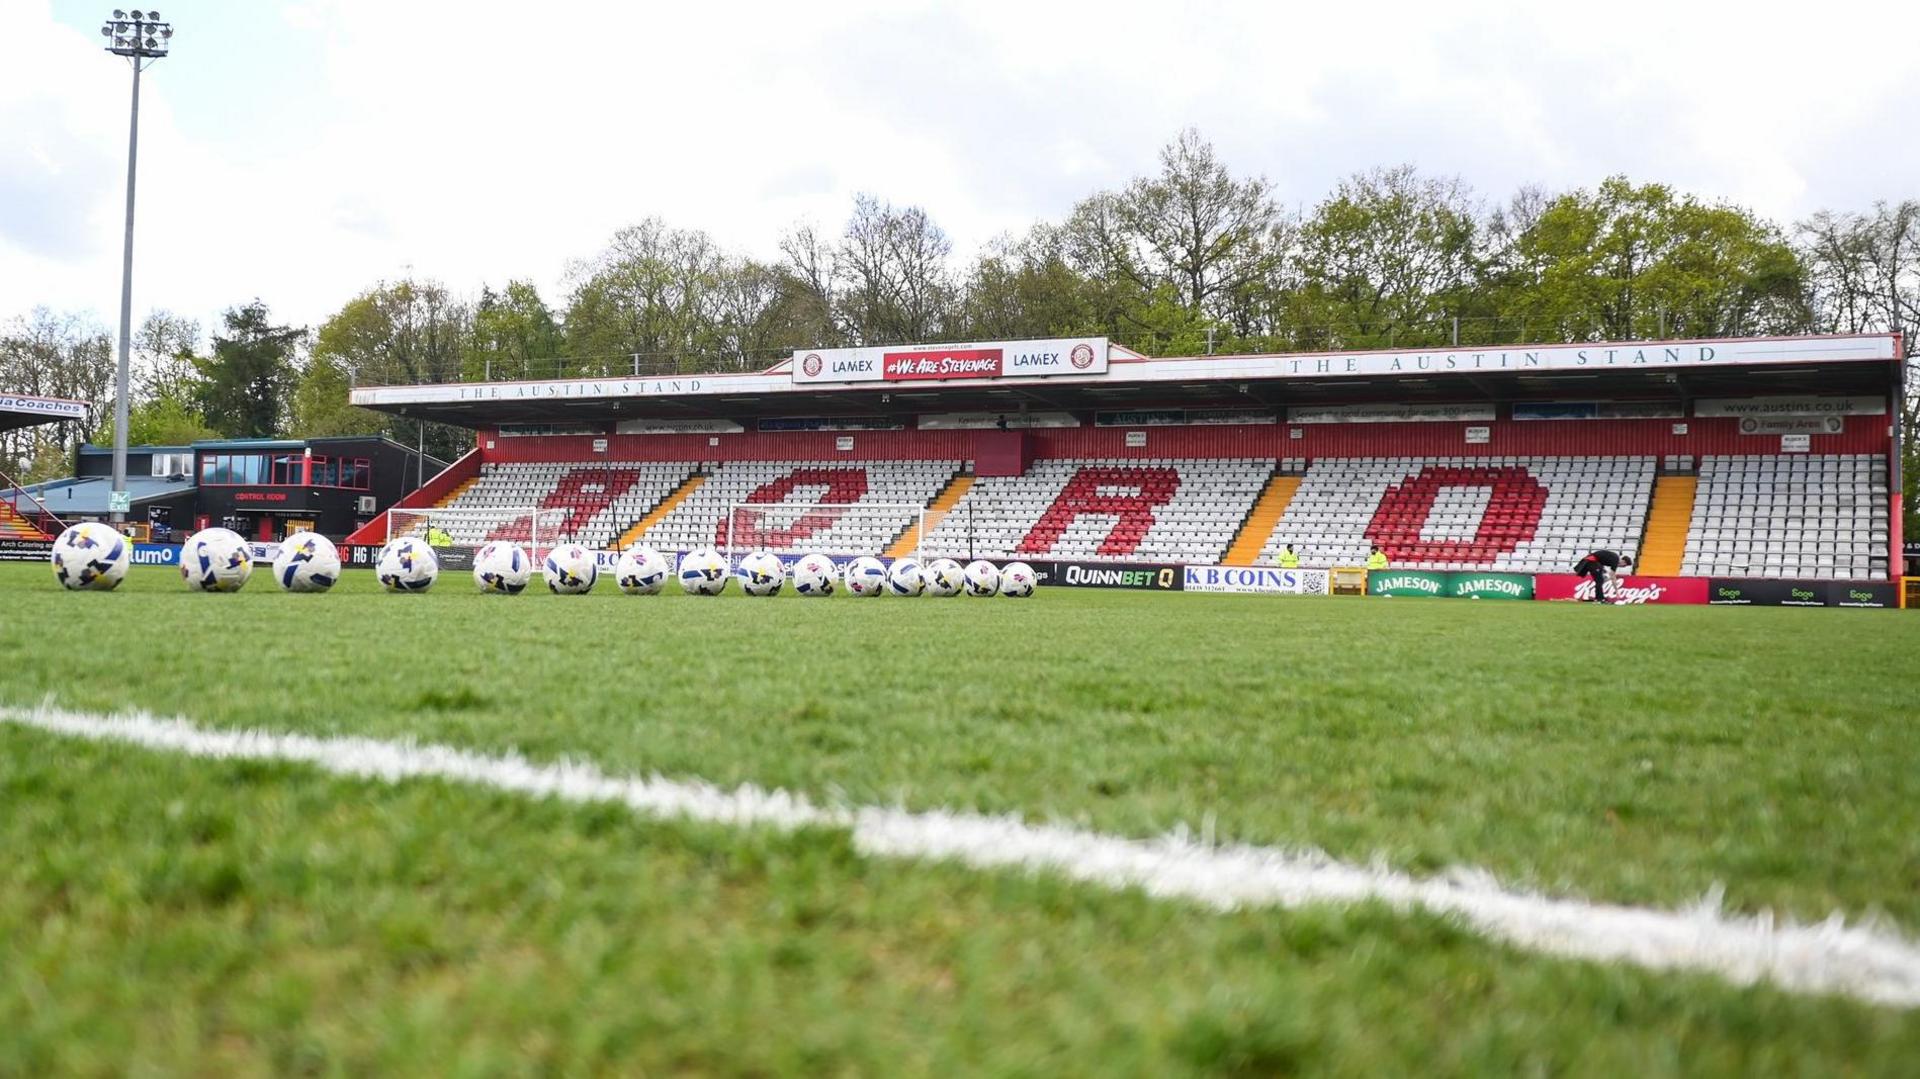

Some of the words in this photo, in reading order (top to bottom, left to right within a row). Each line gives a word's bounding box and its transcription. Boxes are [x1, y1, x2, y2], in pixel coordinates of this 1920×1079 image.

[832, 360, 873, 373] LAMEX
[919, 358, 938, 374] ARE
[940, 357, 998, 374] STEVENAGE
[1014, 353, 1059, 366] LAMEX
[1290, 358, 1357, 373] THE
[1391, 352, 1539, 371] AUSTIN
[1578, 347, 1715, 364] STAND
[459, 387, 498, 399] THE
[517, 383, 602, 397] AUSTIN
[623, 380, 701, 393] STAND
[16, 399, 80, 412] Coaches
[235, 493, 264, 501] CONTROL
[267, 493, 287, 501] ROOM
[110, 503, 128, 511] Exit
[17, 541, 44, 549] Catering
[354, 547, 367, 563] HG
[1066, 566, 1155, 585] QUINNBET
[1186, 568, 1199, 584] K
[1207, 569, 1219, 585] B
[1225, 569, 1296, 587] COINS
[1376, 577, 1439, 594] JAMESON
[1457, 579, 1522, 596] JAMESON
